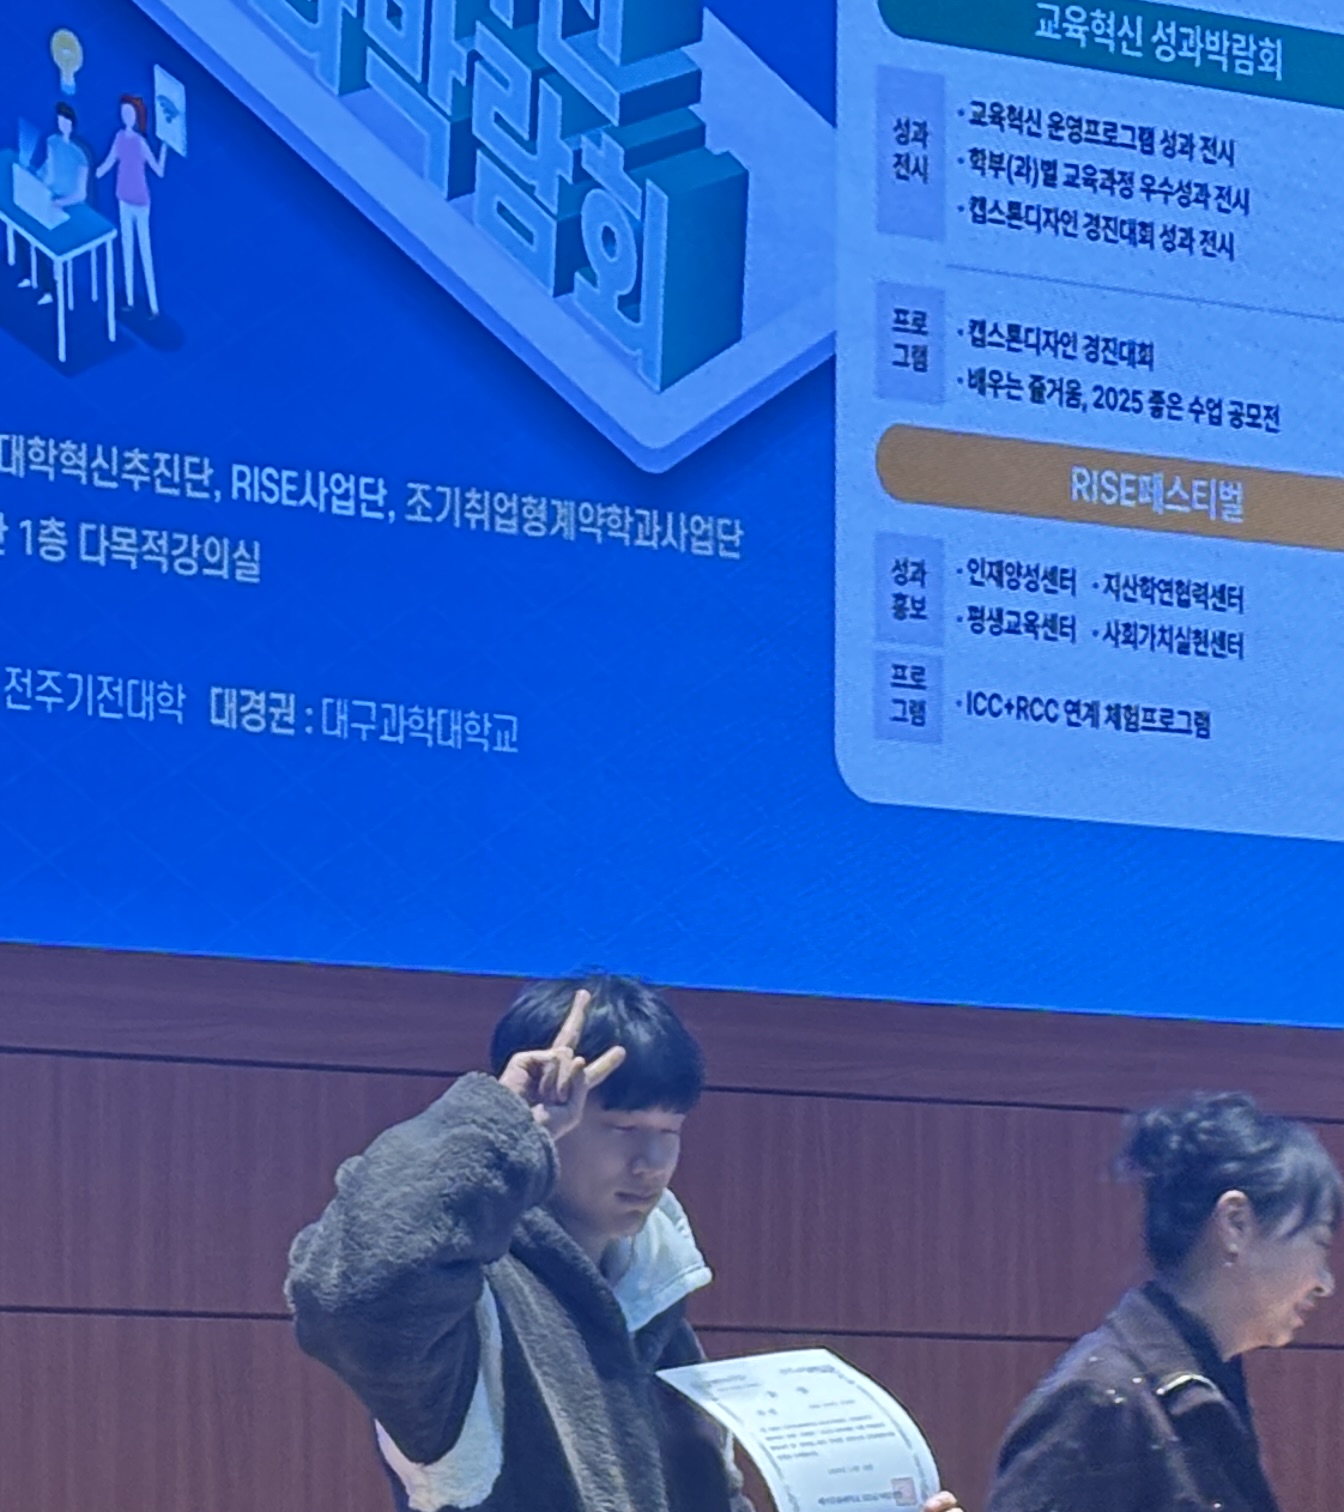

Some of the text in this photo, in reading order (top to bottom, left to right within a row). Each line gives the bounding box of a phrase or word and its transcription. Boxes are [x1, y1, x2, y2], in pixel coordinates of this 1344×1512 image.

[1035, 2, 1283, 81] 교육혁신 성과박람회
[892, 117, 930, 150] 성과
[968, 100, 1043, 139] 교육혁신
[1159, 129, 1197, 163] 성과
[1199, 135, 1235, 169] 전시
[892, 152, 929, 185] 전시
[1062, 162, 1135, 200] 교육과정
[1139, 173, 1212, 211] 우수성과
[1213, 185, 1250, 217] 전시
[1082, 211, 1155, 251] 경진대회
[1158, 223, 1196, 257] 성과
[1199, 229, 1235, 263] 전시
[1082, 334, 1155, 373] 경진대회
[1091, 384, 1144, 415] 2025
[1187, 395, 1223, 427] 수업
[1227, 400, 1281, 434] 공모전
[231, 463, 396, 524] RISE사업단,
[1071, 467, 1244, 524] RISE페스티벌
[19, 517, 68, 562] 1층
[79, 522, 260, 584] 다목적강의실
[890, 557, 929, 589] 성과
[966, 557, 1077, 598] 인재양성센터
[4, 666, 187, 724] 전주기전대학
[210, 686, 296, 735] 대경권
[321, 697, 518, 753] 대구과학대학교
[966, 690, 1060, 724] ICC+RCC
[1063, 698, 1100, 730] 연계
